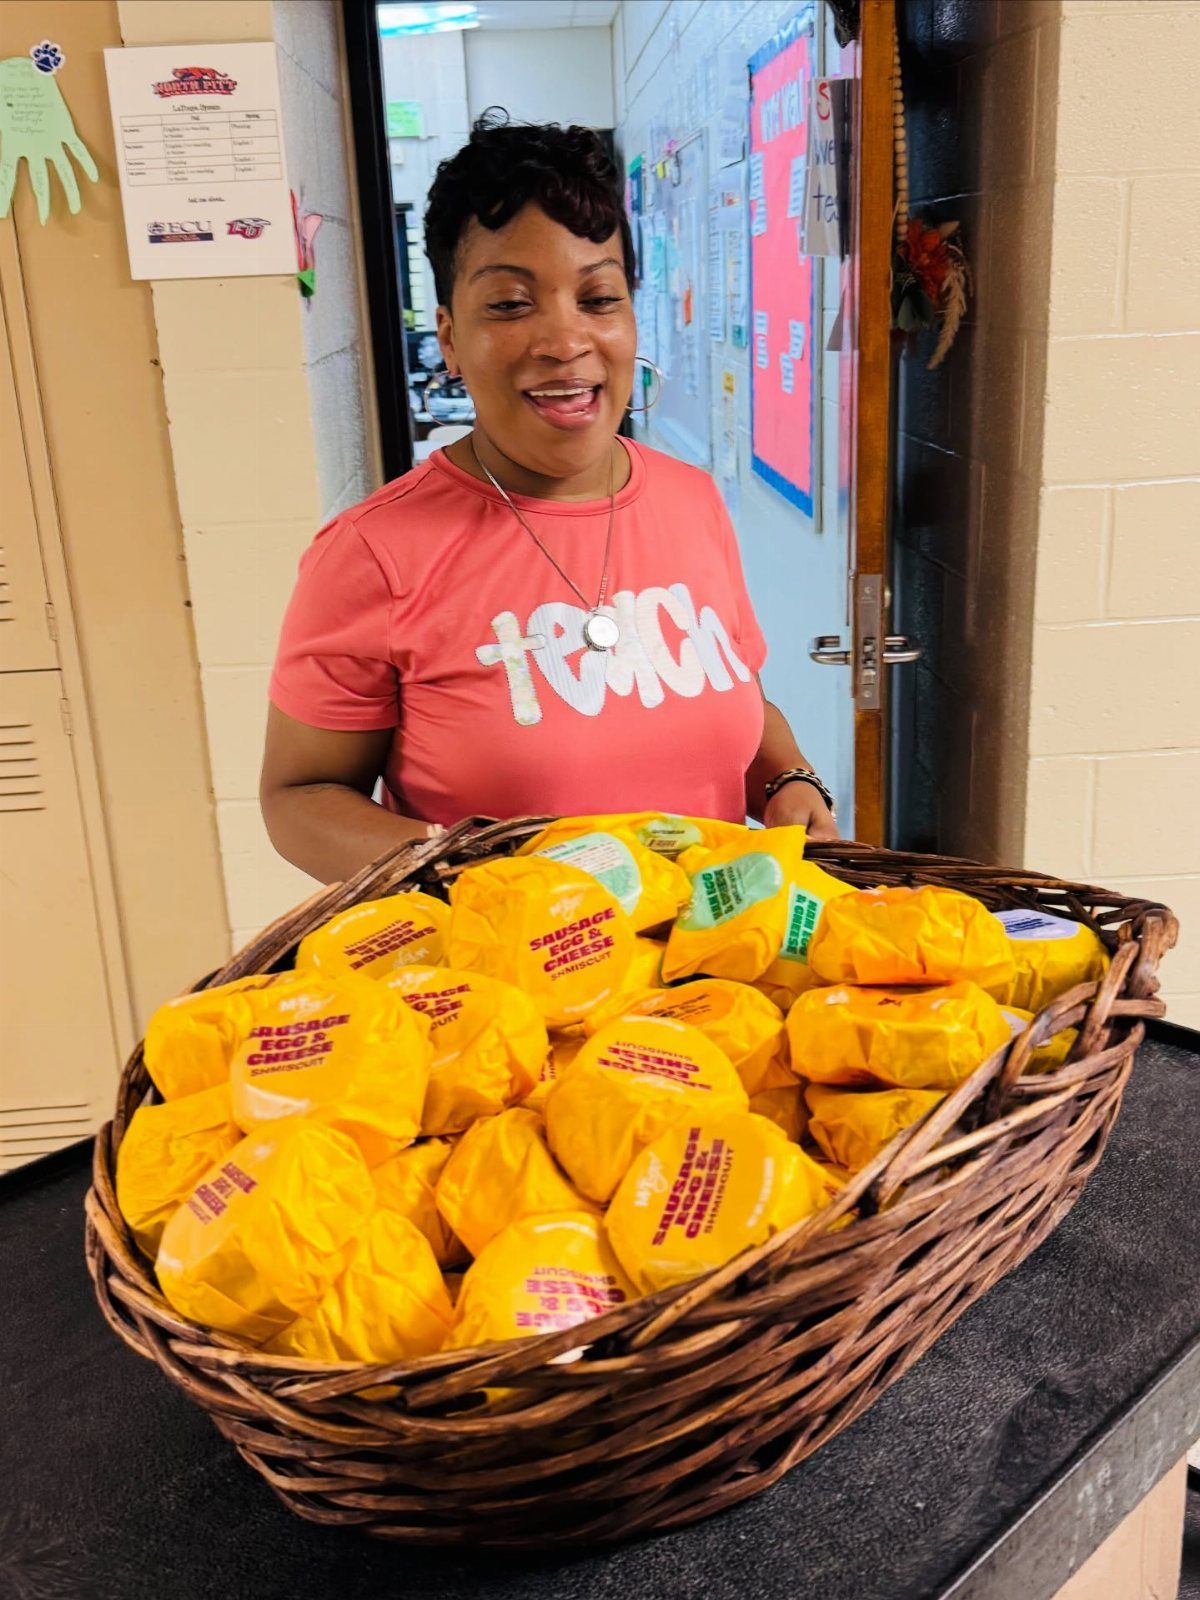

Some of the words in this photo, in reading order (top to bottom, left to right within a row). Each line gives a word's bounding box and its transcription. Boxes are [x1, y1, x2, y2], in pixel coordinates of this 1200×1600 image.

[475, 583, 750, 726] teach
[344, 921, 414, 956] CHEESE
[376, 928, 414, 948] EGG
[529, 907, 616, 951] SAUSAGE
[549, 933, 584, 957] EGG
[588, 928, 603, 940] &
[786, 905, 805, 955] CHEESE
[349, 926, 437, 970] SAUSAGE
[543, 935, 615, 973] CHEESE
[551, 951, 611, 981] SHMISCUIT
[248, 1014, 351, 1039] SAUSAGE
[260, 1035, 308, 1051] EGG
[311, 1032, 327, 1043] &
[246, 1041, 334, 1065] CHEESE
[250, 1057, 325, 1077] SHMISCUIT
[607, 1046, 700, 1072] CHEESE
[652, 1127, 701, 1246] SAUSAGE
[674, 1176, 702, 1225] EGG
[695, 1150, 709, 1169] &
[685, 1139, 724, 1239] CHEESE
[704, 1148, 734, 1234] SHMISCUIT
[525, 1279, 627, 1303] CHEESE
[540, 1297, 559, 1311] &
